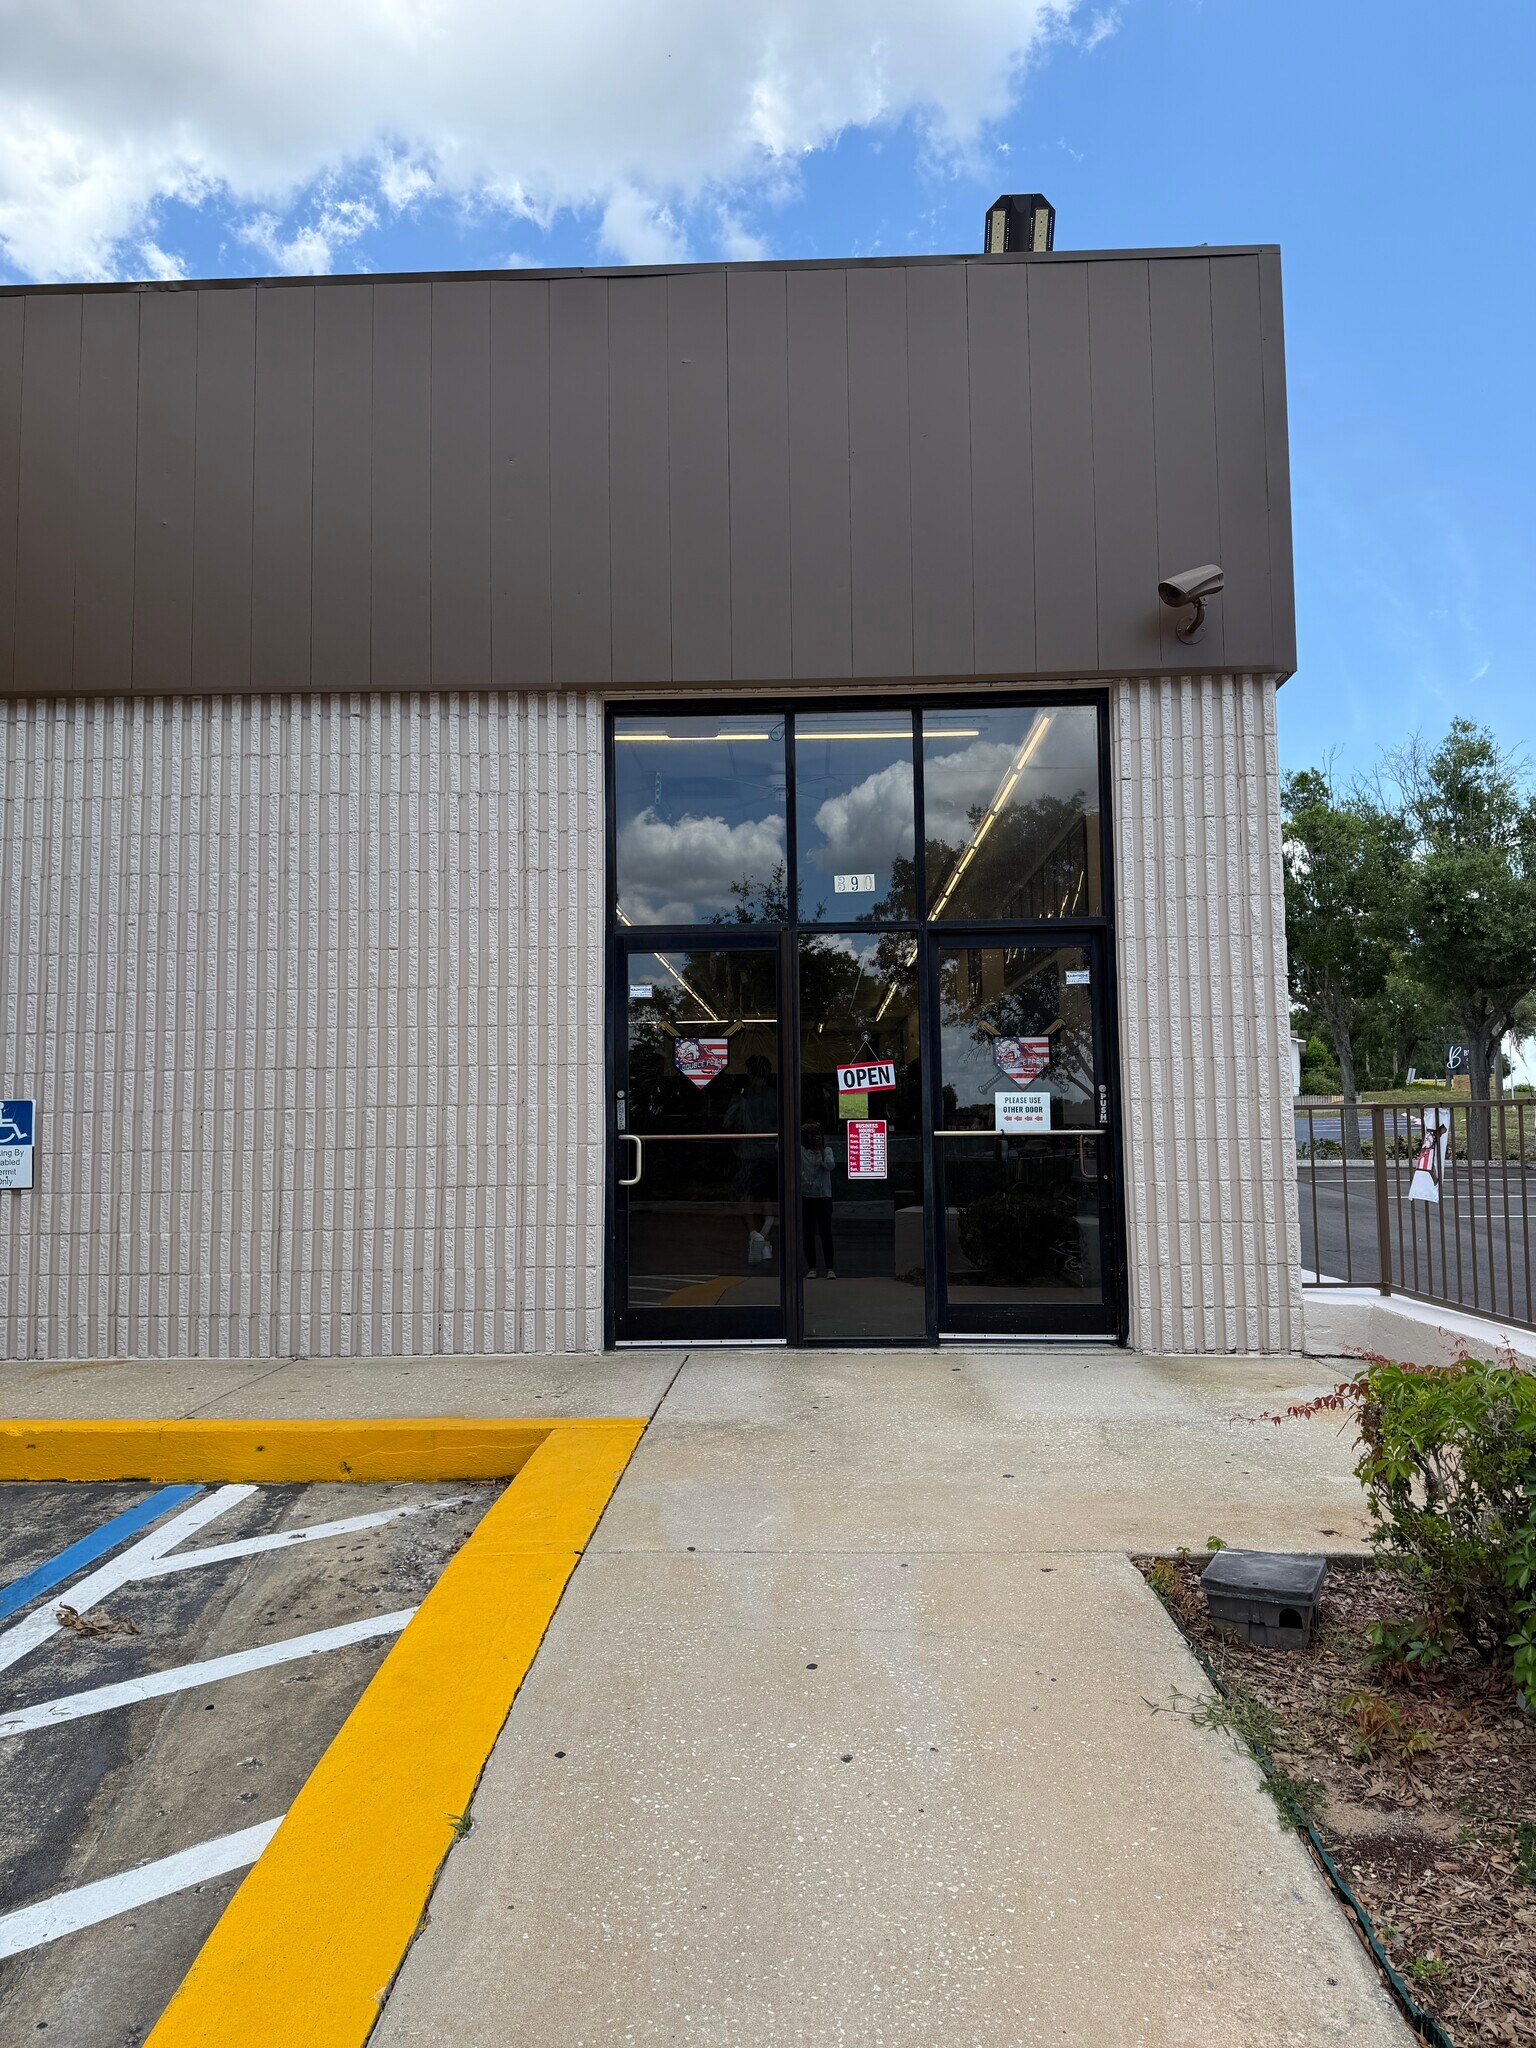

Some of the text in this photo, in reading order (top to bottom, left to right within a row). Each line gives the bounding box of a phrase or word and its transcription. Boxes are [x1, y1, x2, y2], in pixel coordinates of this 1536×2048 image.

[843, 1065, 891, 1088] OPEN
[1004, 1096, 1041, 1104] PLEASE USE
[0, 1149, 24, 1158] ing By
